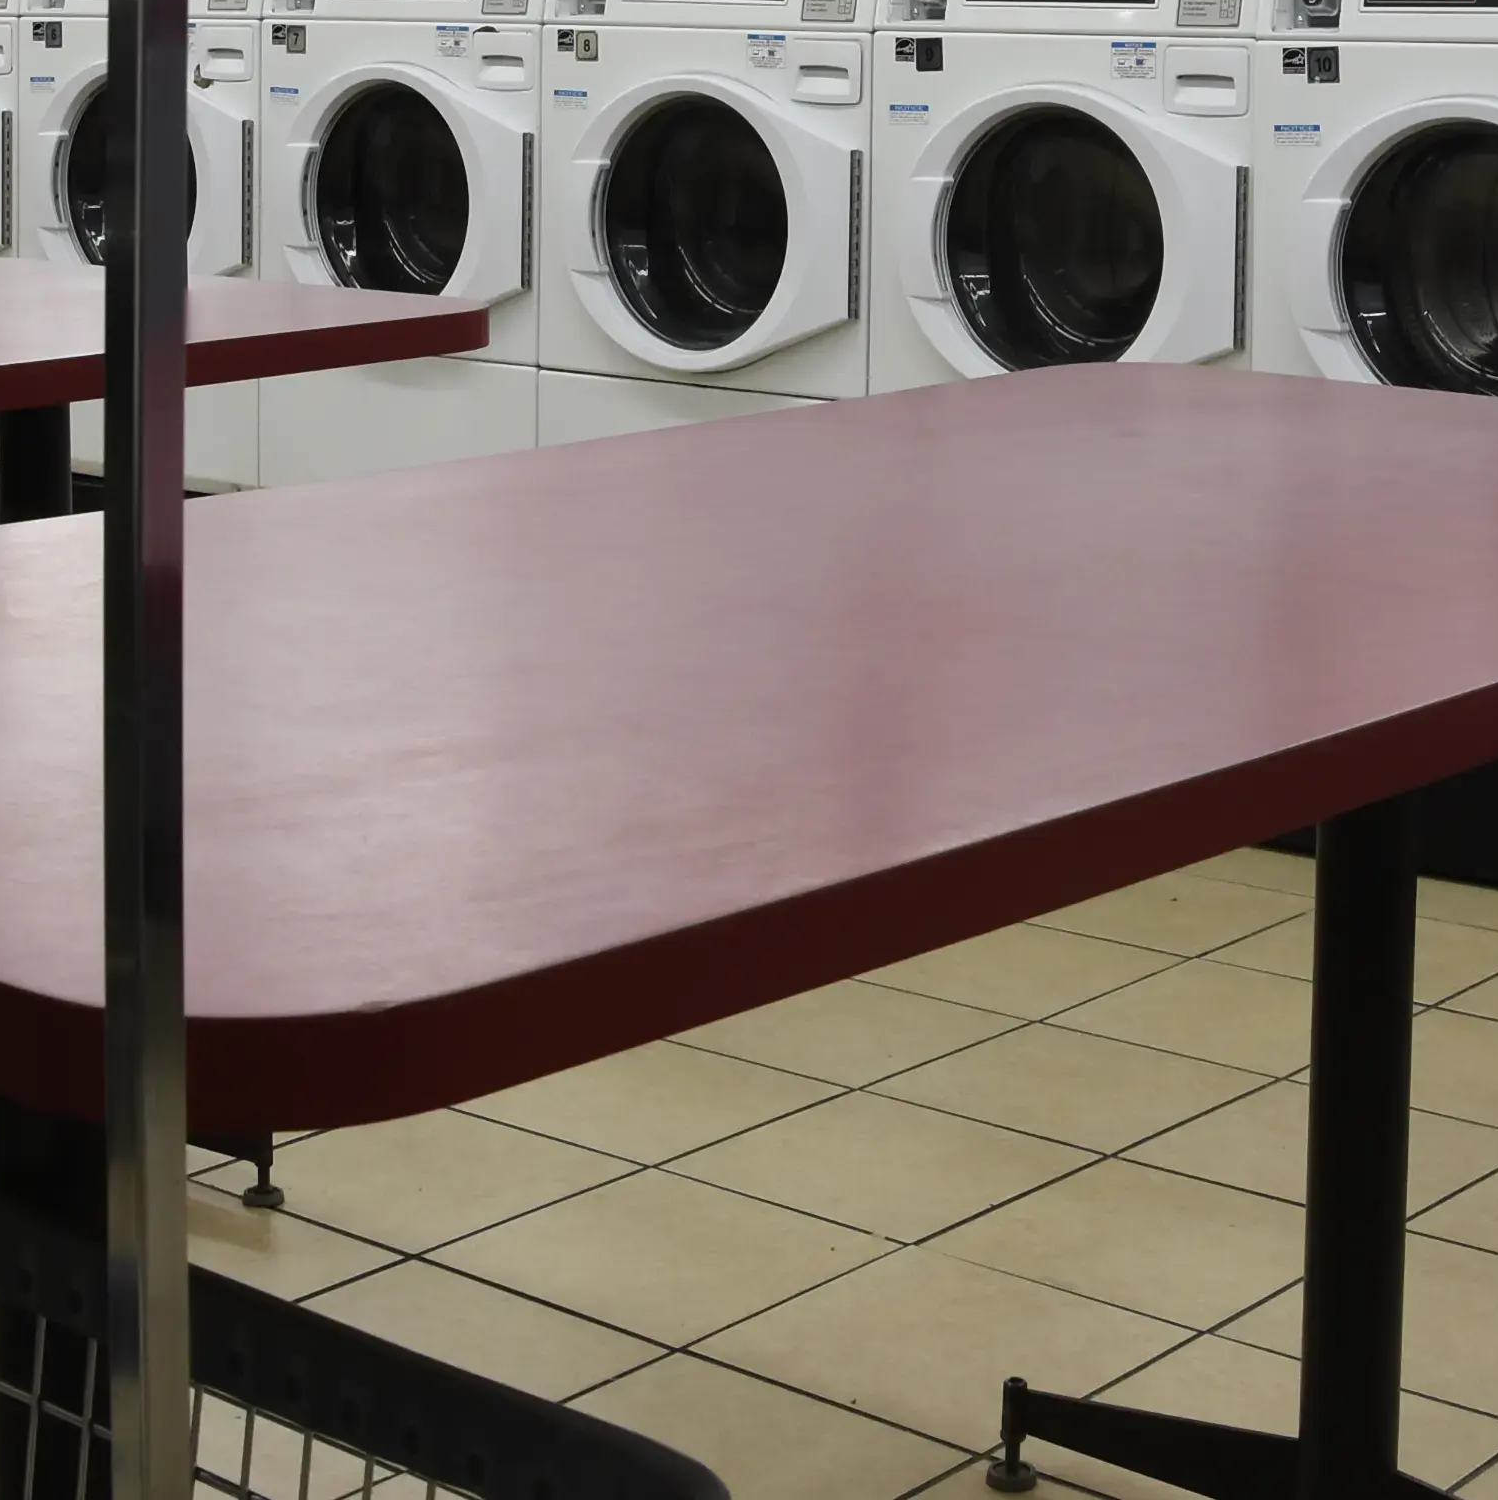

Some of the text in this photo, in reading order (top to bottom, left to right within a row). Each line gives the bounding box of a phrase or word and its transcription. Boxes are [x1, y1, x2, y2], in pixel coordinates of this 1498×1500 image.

[292, 32, 300, 46] 7
[583, 38, 591, 53] 8
[1315, 56, 1332, 73] 10
